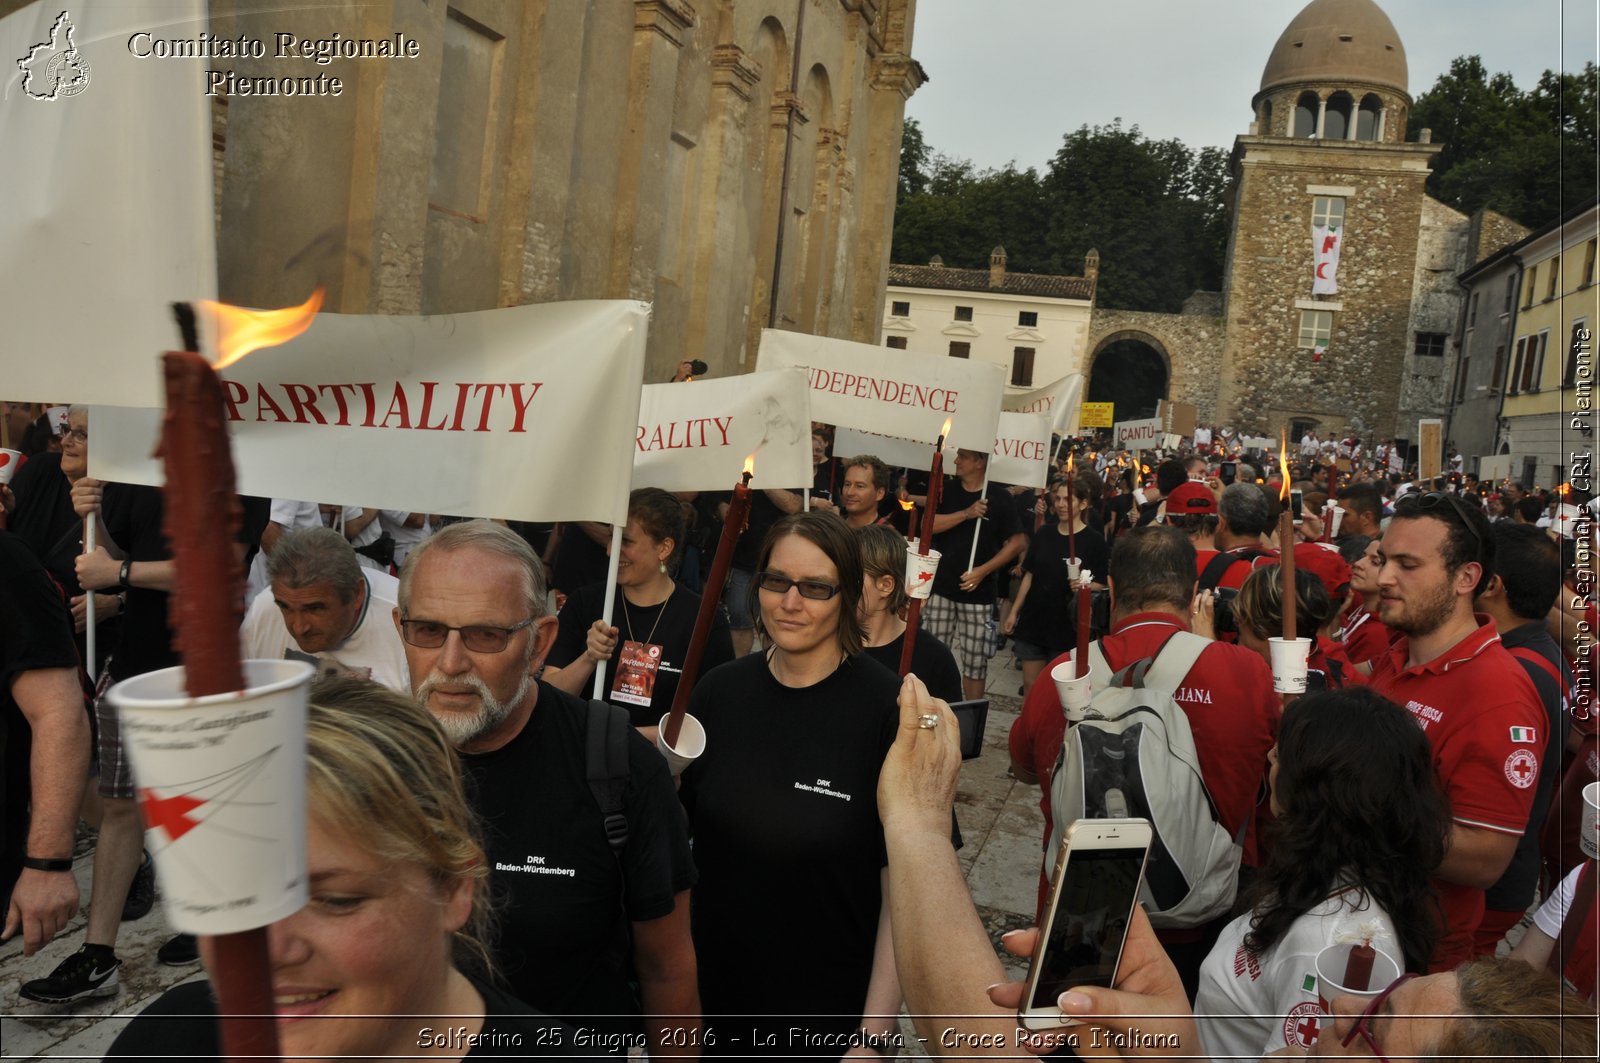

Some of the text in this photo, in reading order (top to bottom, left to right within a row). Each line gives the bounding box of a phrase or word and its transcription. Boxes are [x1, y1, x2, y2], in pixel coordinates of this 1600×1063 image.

[816, 778, 831, 788] DRK
[794, 781, 851, 802] Baden-Württemberg
[526, 855, 545, 865] DRK
[495, 862, 576, 877] Baden-Württemberg
